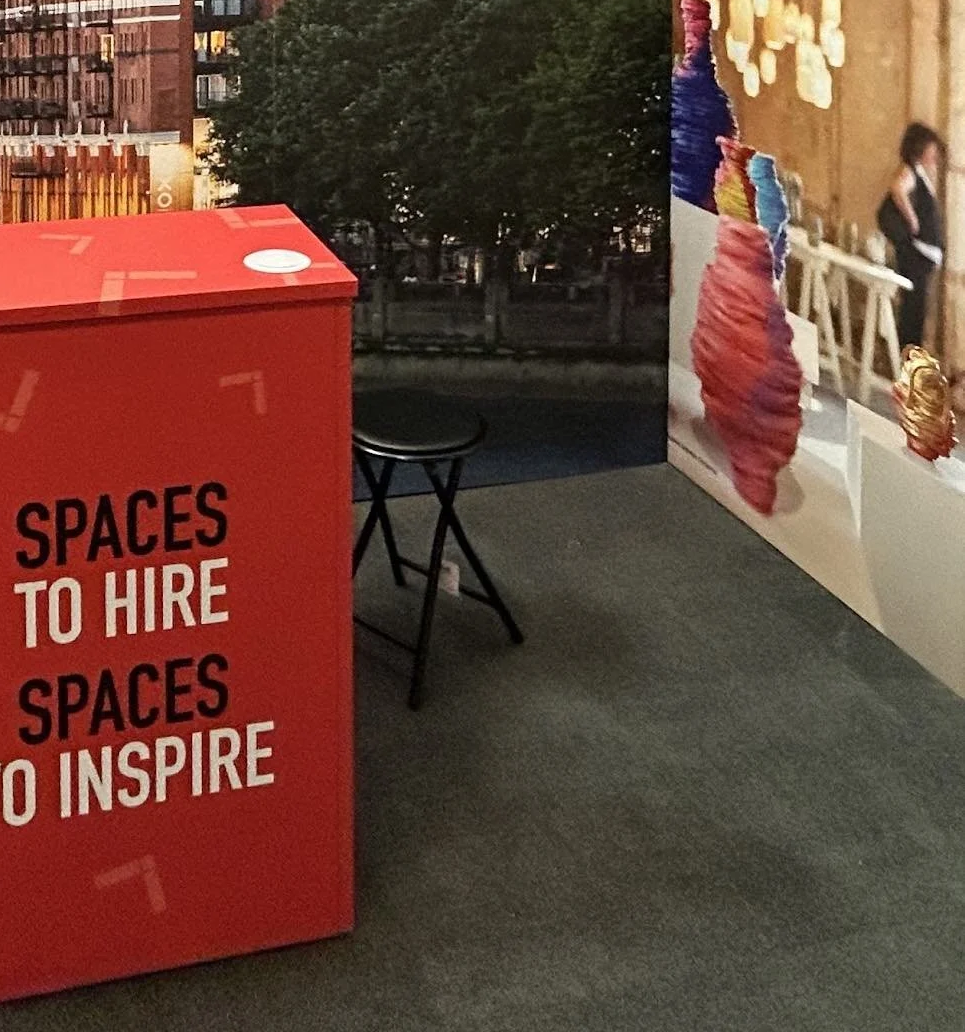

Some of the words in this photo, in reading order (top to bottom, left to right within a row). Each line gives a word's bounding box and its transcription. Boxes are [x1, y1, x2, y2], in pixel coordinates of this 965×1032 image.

[15, 481, 228, 569] SPACES
[13, 576, 82, 649] TO
[105, 557, 229, 638] HIRE
[18, 653, 229, 746] SPACES
[59, 720, 275, 819] INSPIRE
